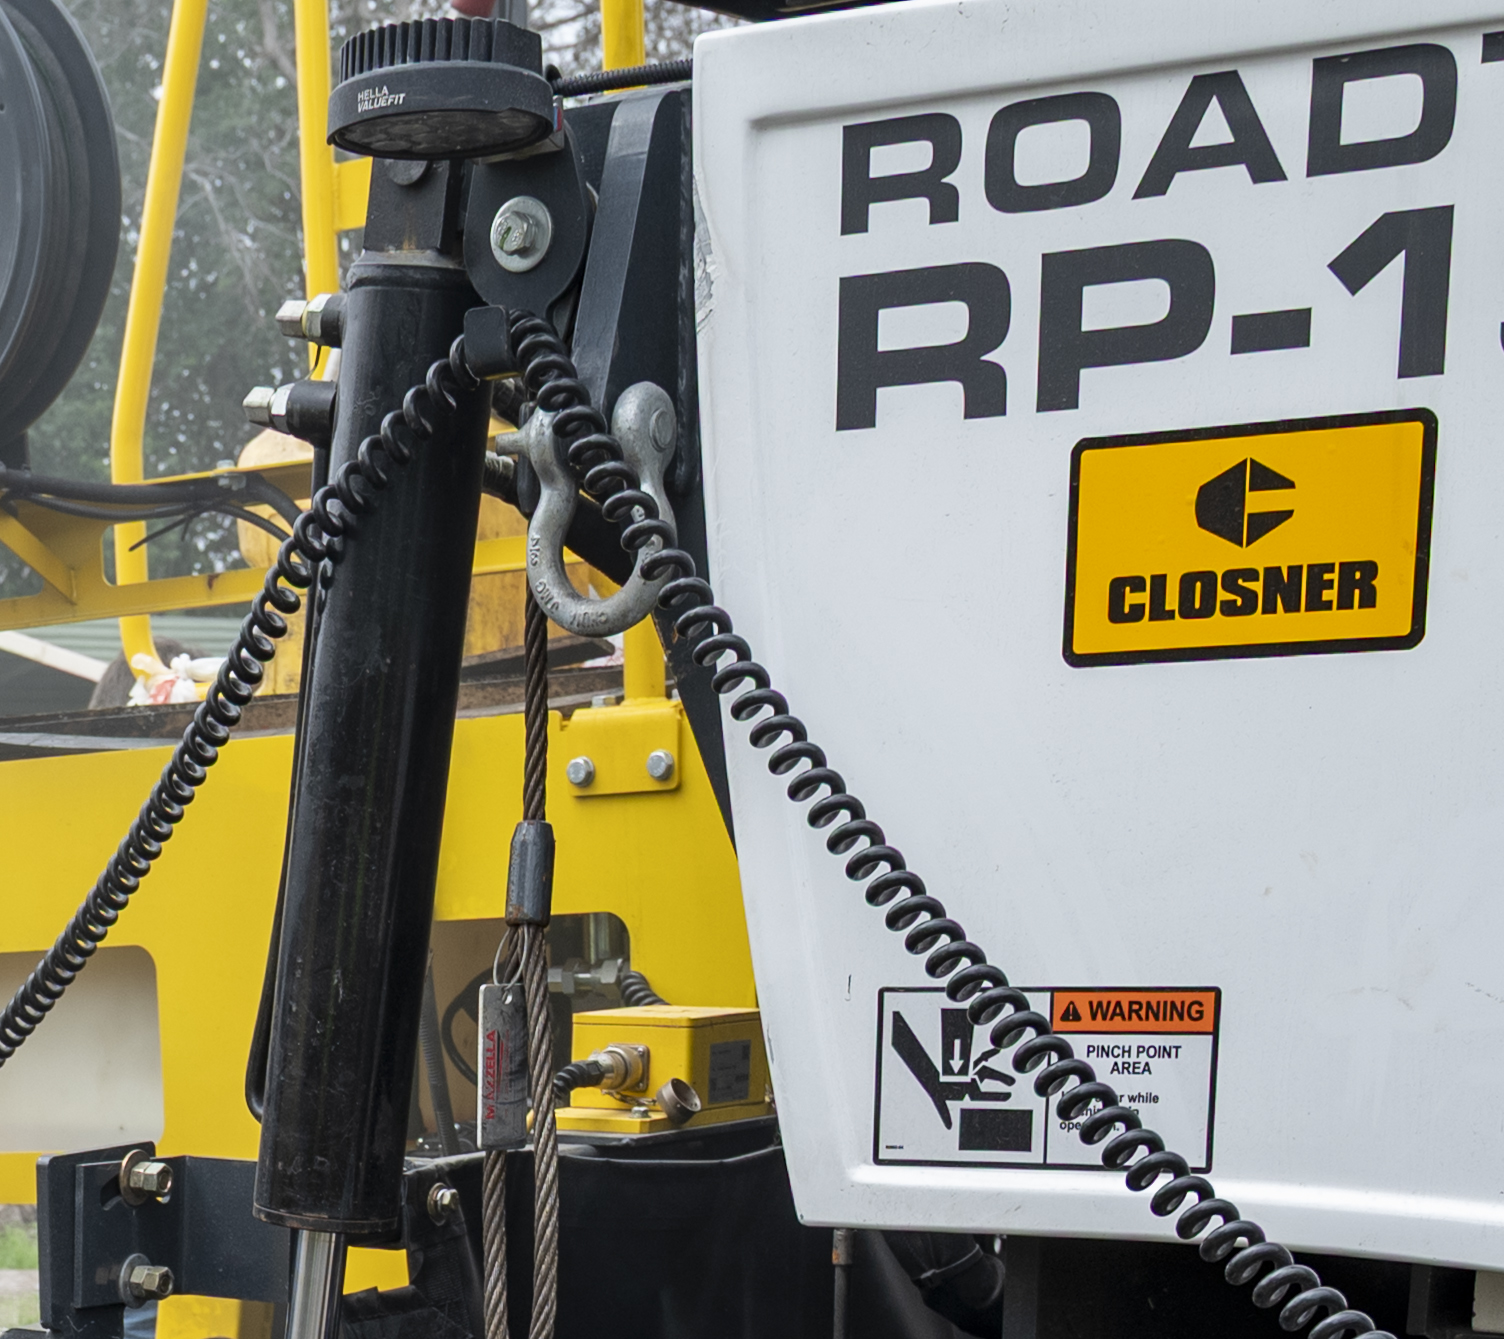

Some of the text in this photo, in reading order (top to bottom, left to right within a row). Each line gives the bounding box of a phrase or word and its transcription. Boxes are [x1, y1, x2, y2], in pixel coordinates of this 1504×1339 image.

[358, 85, 389, 102] HELLA
[357, 93, 406, 113] VALUEFIT
[1107, 560, 1380, 627] CLOSNER
[1089, 1000, 1205, 1022] WARNING
[1086, 1044, 1182, 1059] PINCH POINT
[1110, 1060, 1152, 1075] AREA
[1128, 1092, 1159, 1103] while
